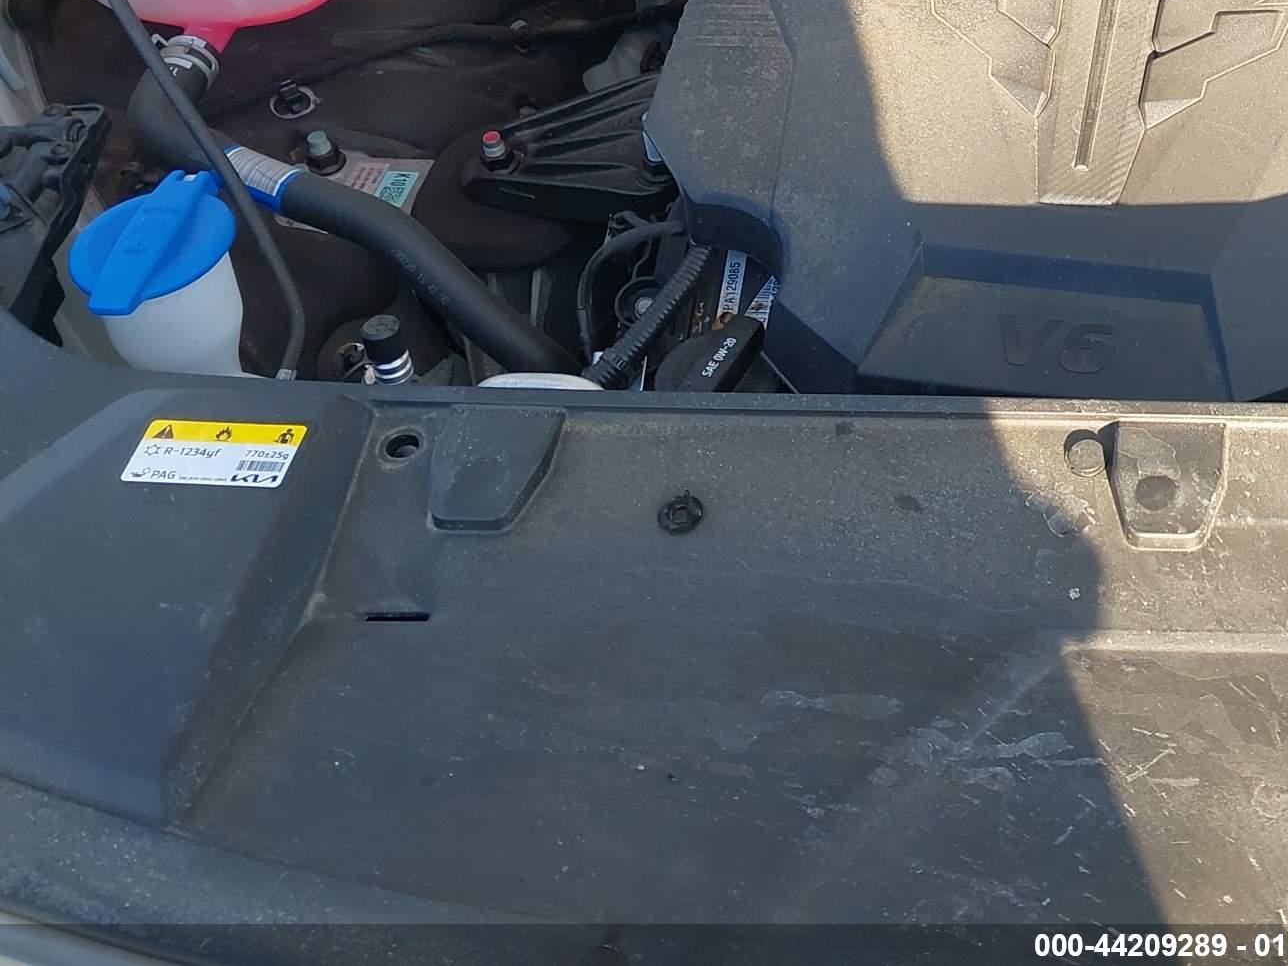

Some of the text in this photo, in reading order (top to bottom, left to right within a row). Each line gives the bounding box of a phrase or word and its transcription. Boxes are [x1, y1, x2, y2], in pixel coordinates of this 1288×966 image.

[390, 172, 411, 187] K10
[998, 314, 1114, 375] V6
[701, 337, 737, 378] SAE 0W-20
[164, 448, 290, 461] R-1234yf 770±25g
[150, 470, 177, 480] PAG
